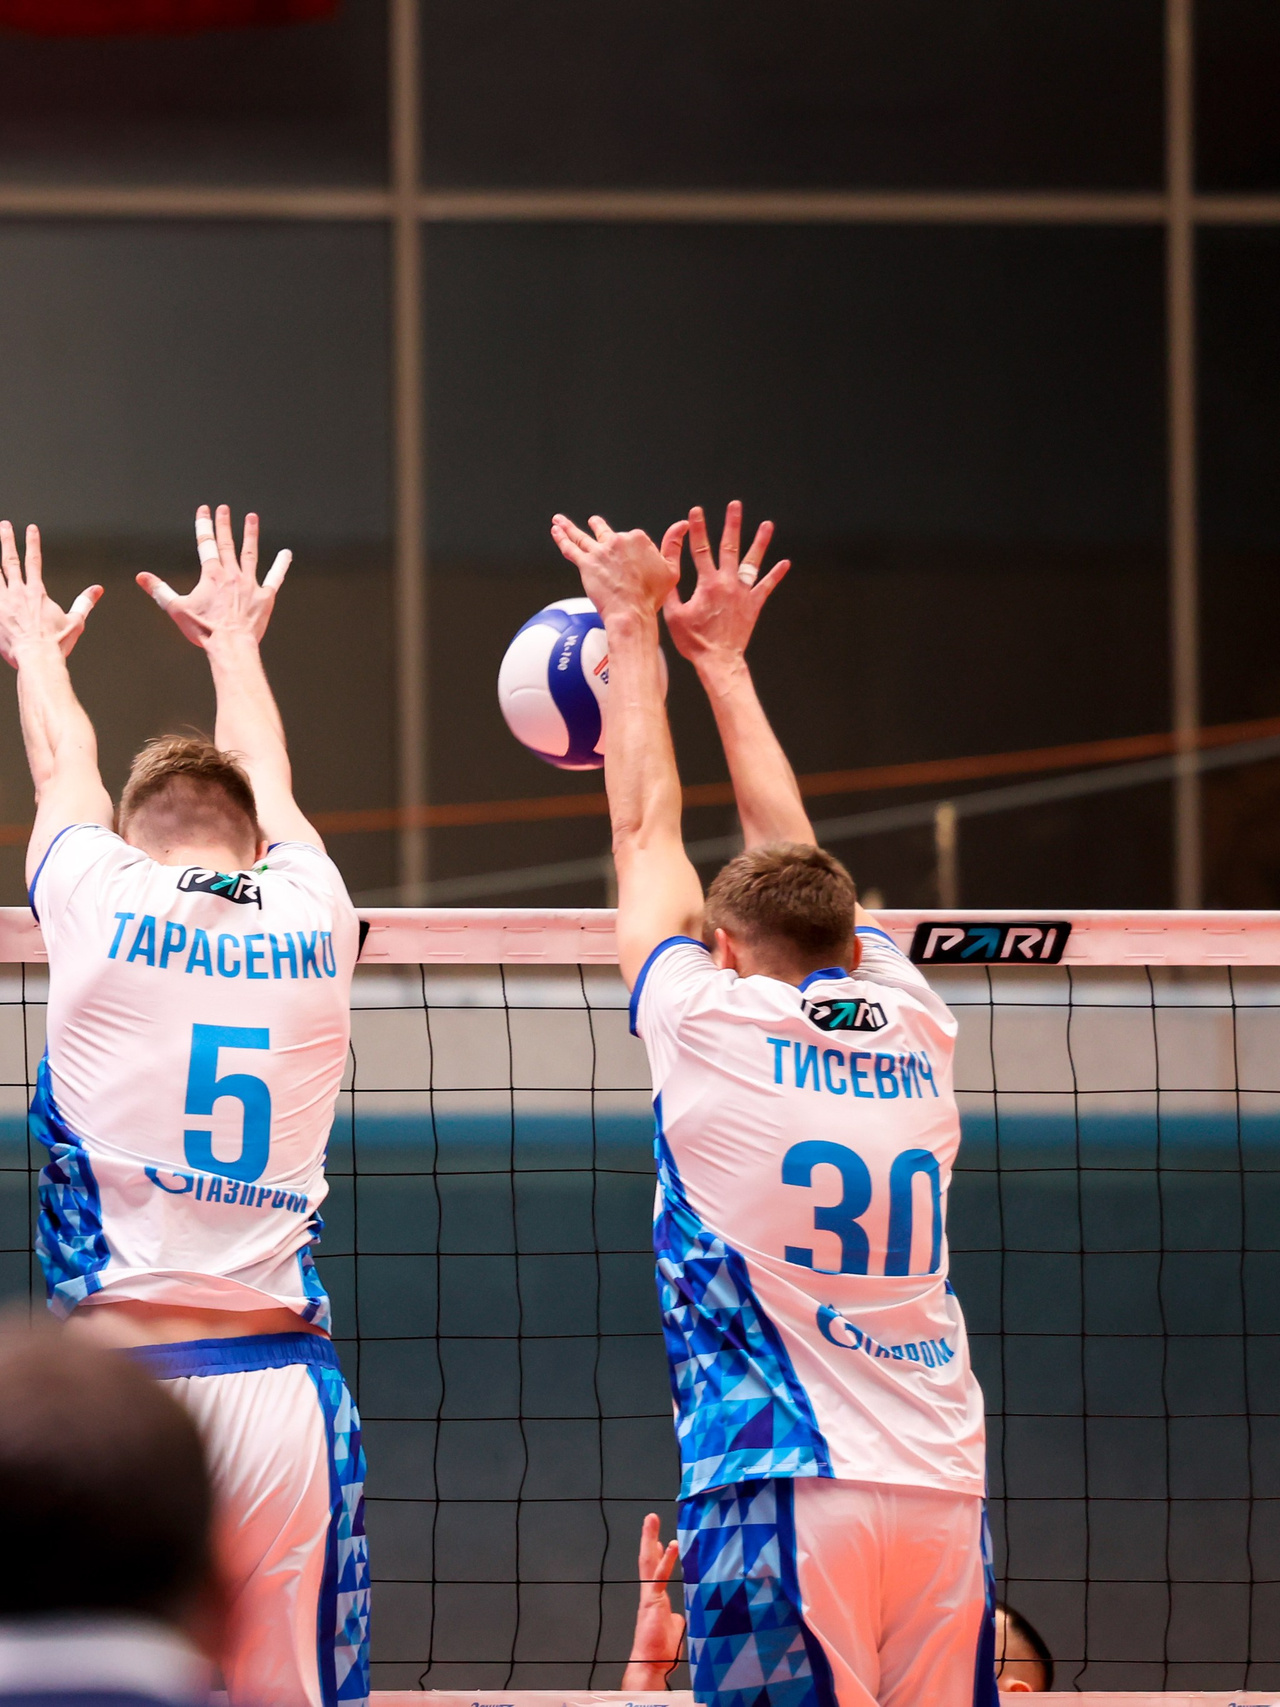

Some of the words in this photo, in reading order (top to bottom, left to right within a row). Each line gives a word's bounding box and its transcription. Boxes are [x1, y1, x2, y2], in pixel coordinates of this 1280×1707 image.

[180, 869, 260, 900] PAR
[107, 912, 337, 979] ТАРАСЕНКО
[922, 927, 1058, 959] PARI
[766, 1037, 939, 1099] ТИСЕВИЧ
[184, 1023, 271, 1184] 5
[782, 1139, 942, 1277] 30
